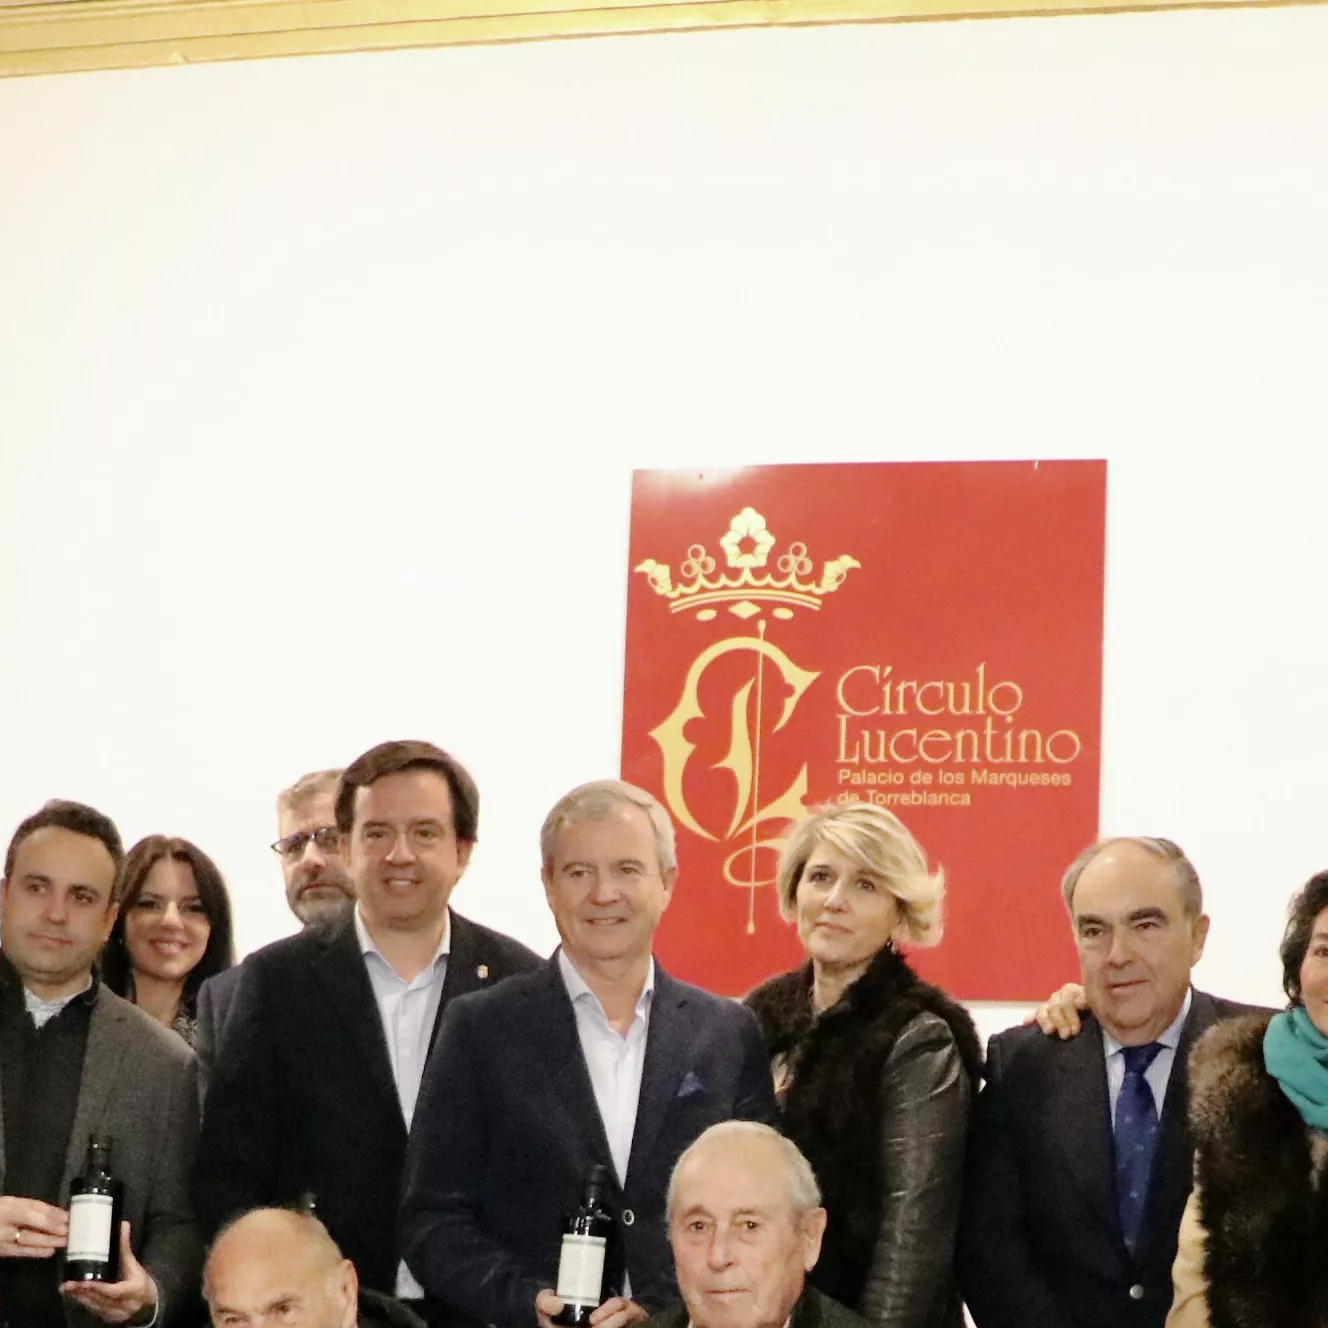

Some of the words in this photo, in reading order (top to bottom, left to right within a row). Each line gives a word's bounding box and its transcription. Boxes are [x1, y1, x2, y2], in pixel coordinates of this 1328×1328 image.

[836, 660, 1023, 717] Círculo
[836, 713, 1082, 766] Lucentino
[838, 768, 904, 786] Palacio
[910, 768, 933, 786] de
[939, 768, 965, 786] los
[971, 768, 1072, 788] Marqueses
[837, 790, 861, 806] de
[867, 789, 972, 806] Torreblanca
